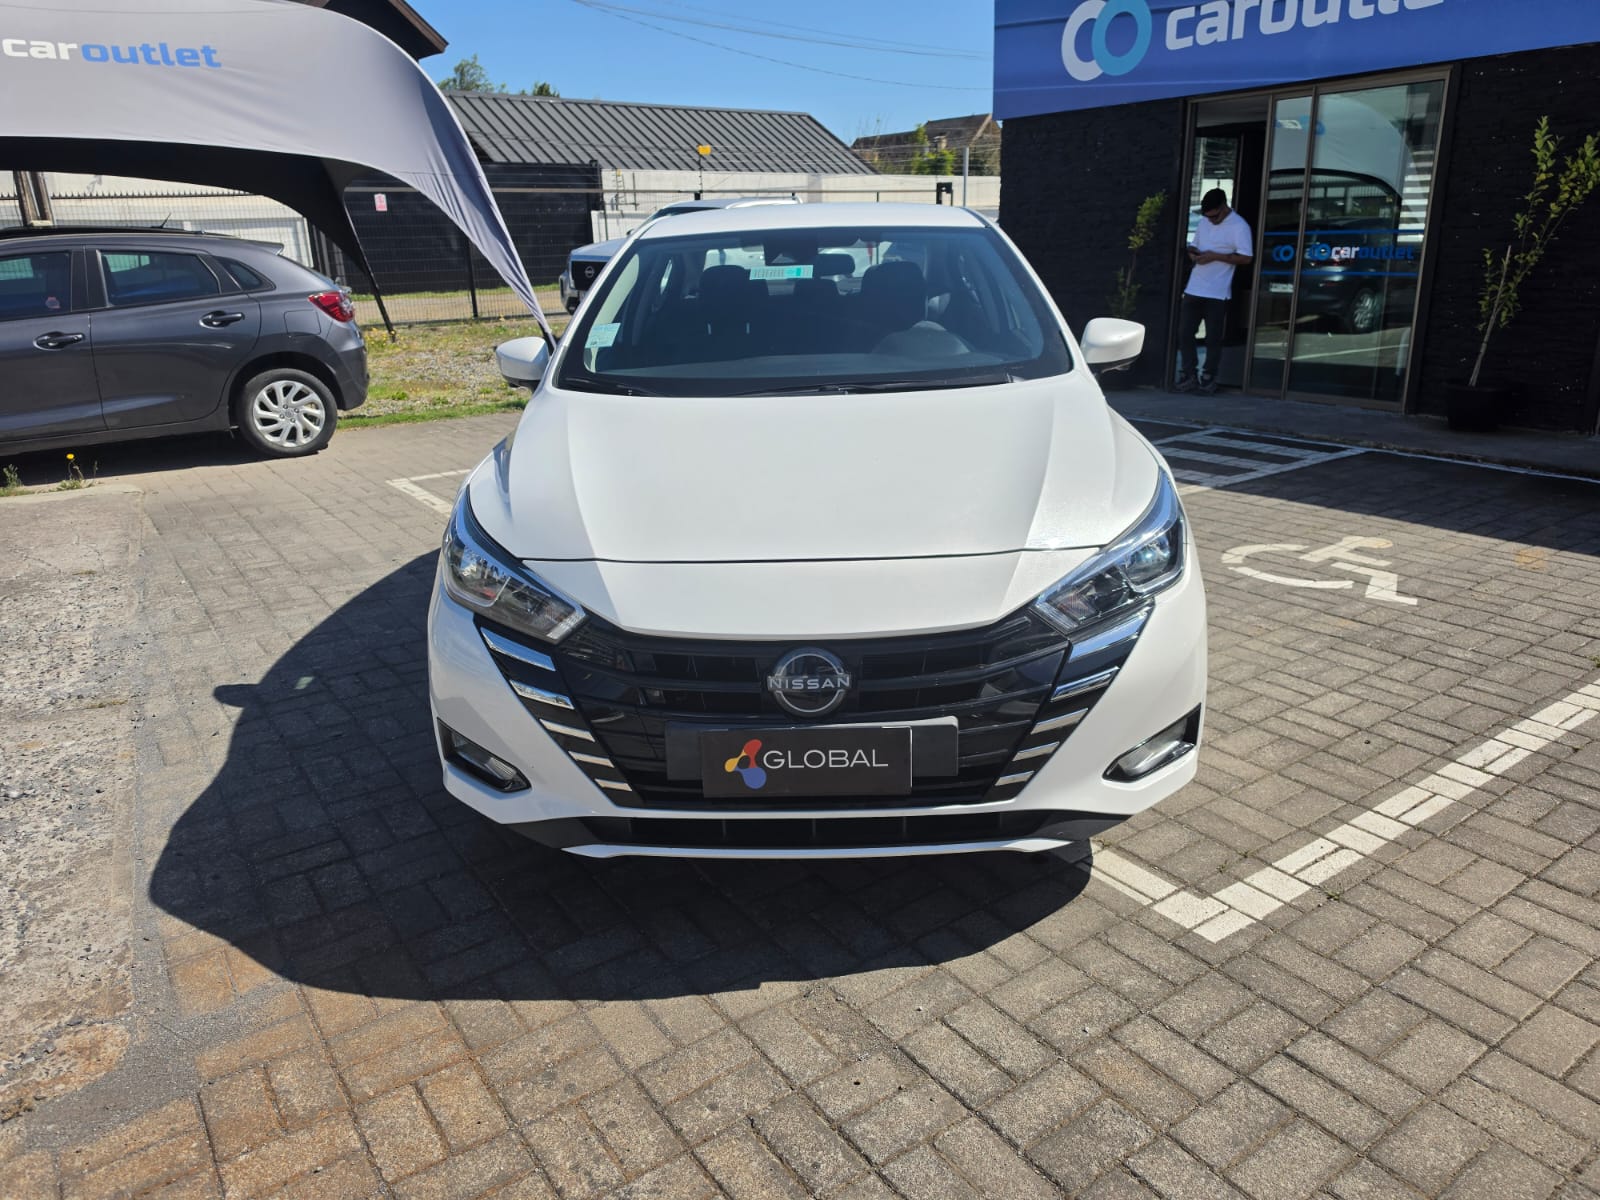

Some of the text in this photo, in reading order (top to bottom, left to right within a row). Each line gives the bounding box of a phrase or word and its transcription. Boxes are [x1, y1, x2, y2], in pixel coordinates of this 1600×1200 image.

[2, 38, 222, 68] caroutlet
[1331, 244, 1415, 261] caroutlet
[769, 676, 850, 690] NISSAN
[763, 749, 889, 769] GLOBAL
